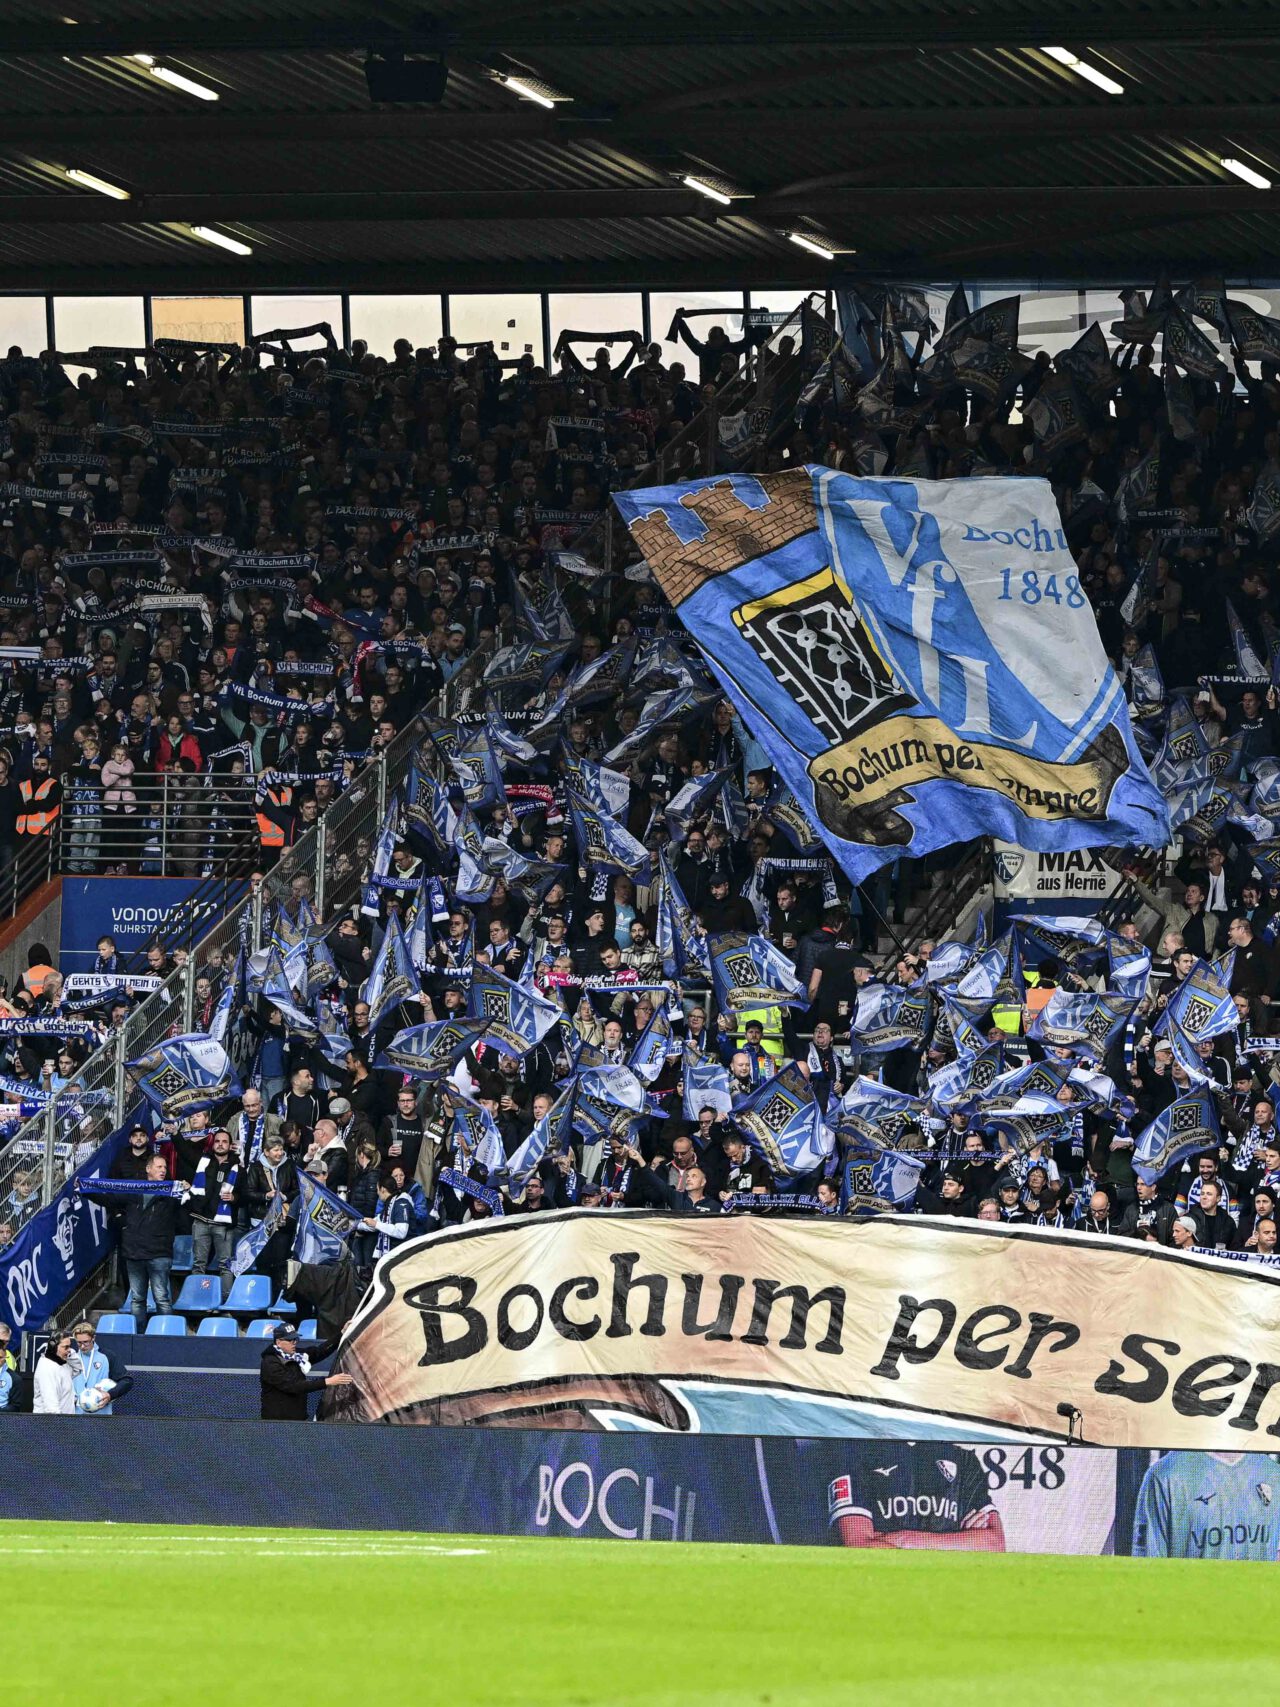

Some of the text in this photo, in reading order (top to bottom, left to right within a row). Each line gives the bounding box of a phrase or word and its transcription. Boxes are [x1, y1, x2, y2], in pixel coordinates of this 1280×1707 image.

[24, 486, 62, 499] BOCHUM
[962, 520, 1068, 554] Bochu
[245, 557, 257, 567] VfL
[259, 557, 288, 567] Bochum
[230, 578, 277, 589] BOCHUM
[996, 570, 1086, 610] 1848
[0, 596, 28, 606] CHUM
[80, 610, 120, 622] BOCHUM
[845, 497, 1040, 751] VfL
[299, 662, 334, 673] BOCHUM
[232, 683, 309, 711] VfL Bochum 1848
[457, 712, 471, 726] VfL
[820, 733, 934, 803] Bochum
[1000, 776, 1097, 817] empre
[1036, 849, 1106, 873] MAX
[1037, 872, 1106, 891] aus Herne
[115, 977, 128, 988] DU
[129, 977, 152, 989] MEIN
[730, 990, 772, 1003] Bochum per
[19, 1022, 87, 1034] VfL BOCHUM
[1248, 1037, 1271, 1047] VfL
[199, 1045, 219, 1058] 1848
[8, 1079, 55, 1100] HEIMAT
[615, 1081, 634, 1093] 1848
[163, 1093, 191, 1111] Bochum
[746, 1111, 766, 1138] Bochum
[897, 1170, 915, 1179] 1848
[759, 1193, 796, 1205] ALLEZ
[404, 1251, 846, 1368] Bochum
[870, 1294, 1080, 1381] per
[982, 1446, 1066, 1491] 848
[535, 1461, 697, 1542] BOCH
